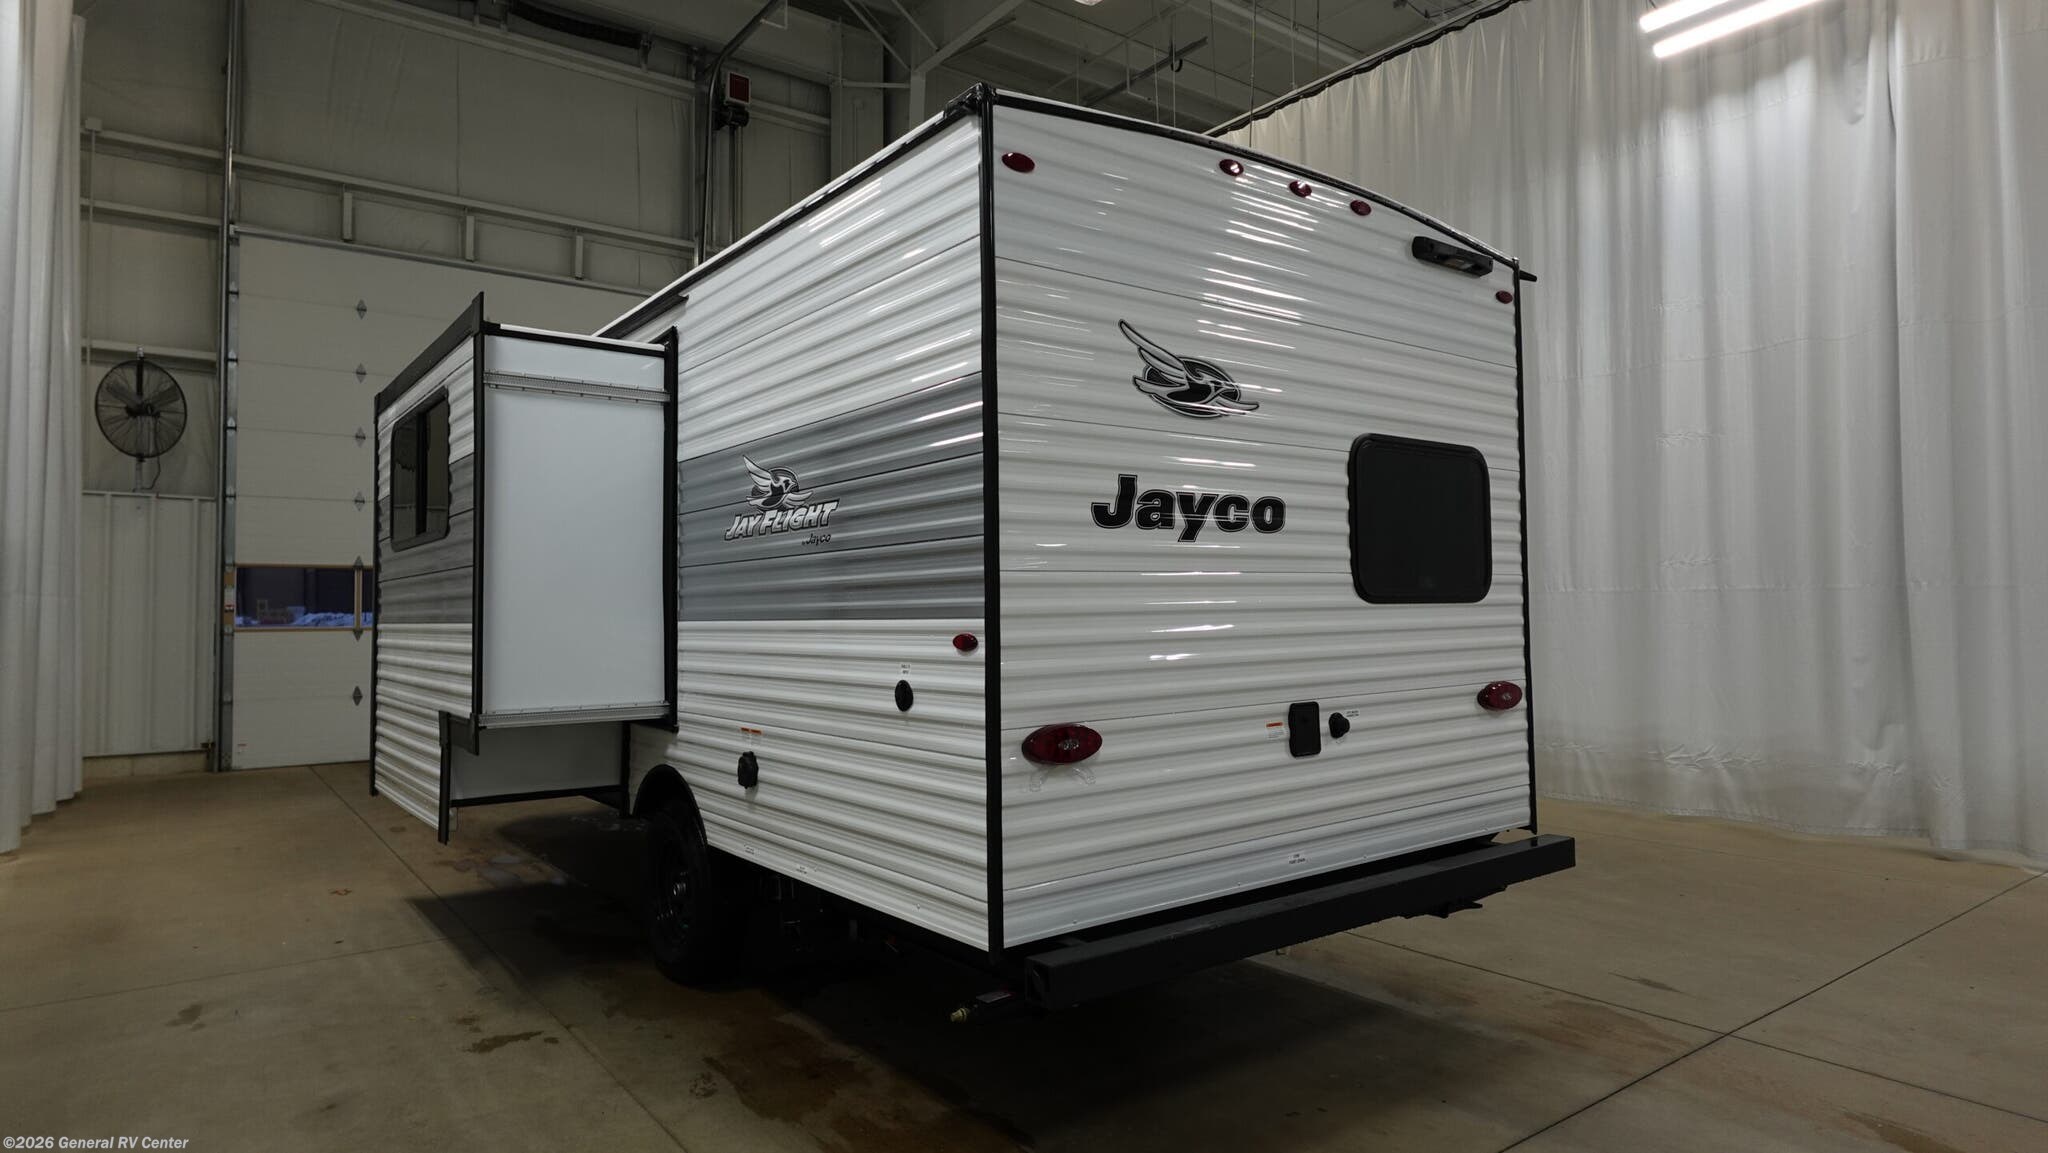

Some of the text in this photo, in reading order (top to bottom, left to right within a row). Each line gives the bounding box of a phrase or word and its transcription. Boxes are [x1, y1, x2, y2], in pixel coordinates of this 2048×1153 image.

[724, 499, 839, 541] JAY FLIGHT
[1091, 474, 1286, 542] Jayco
